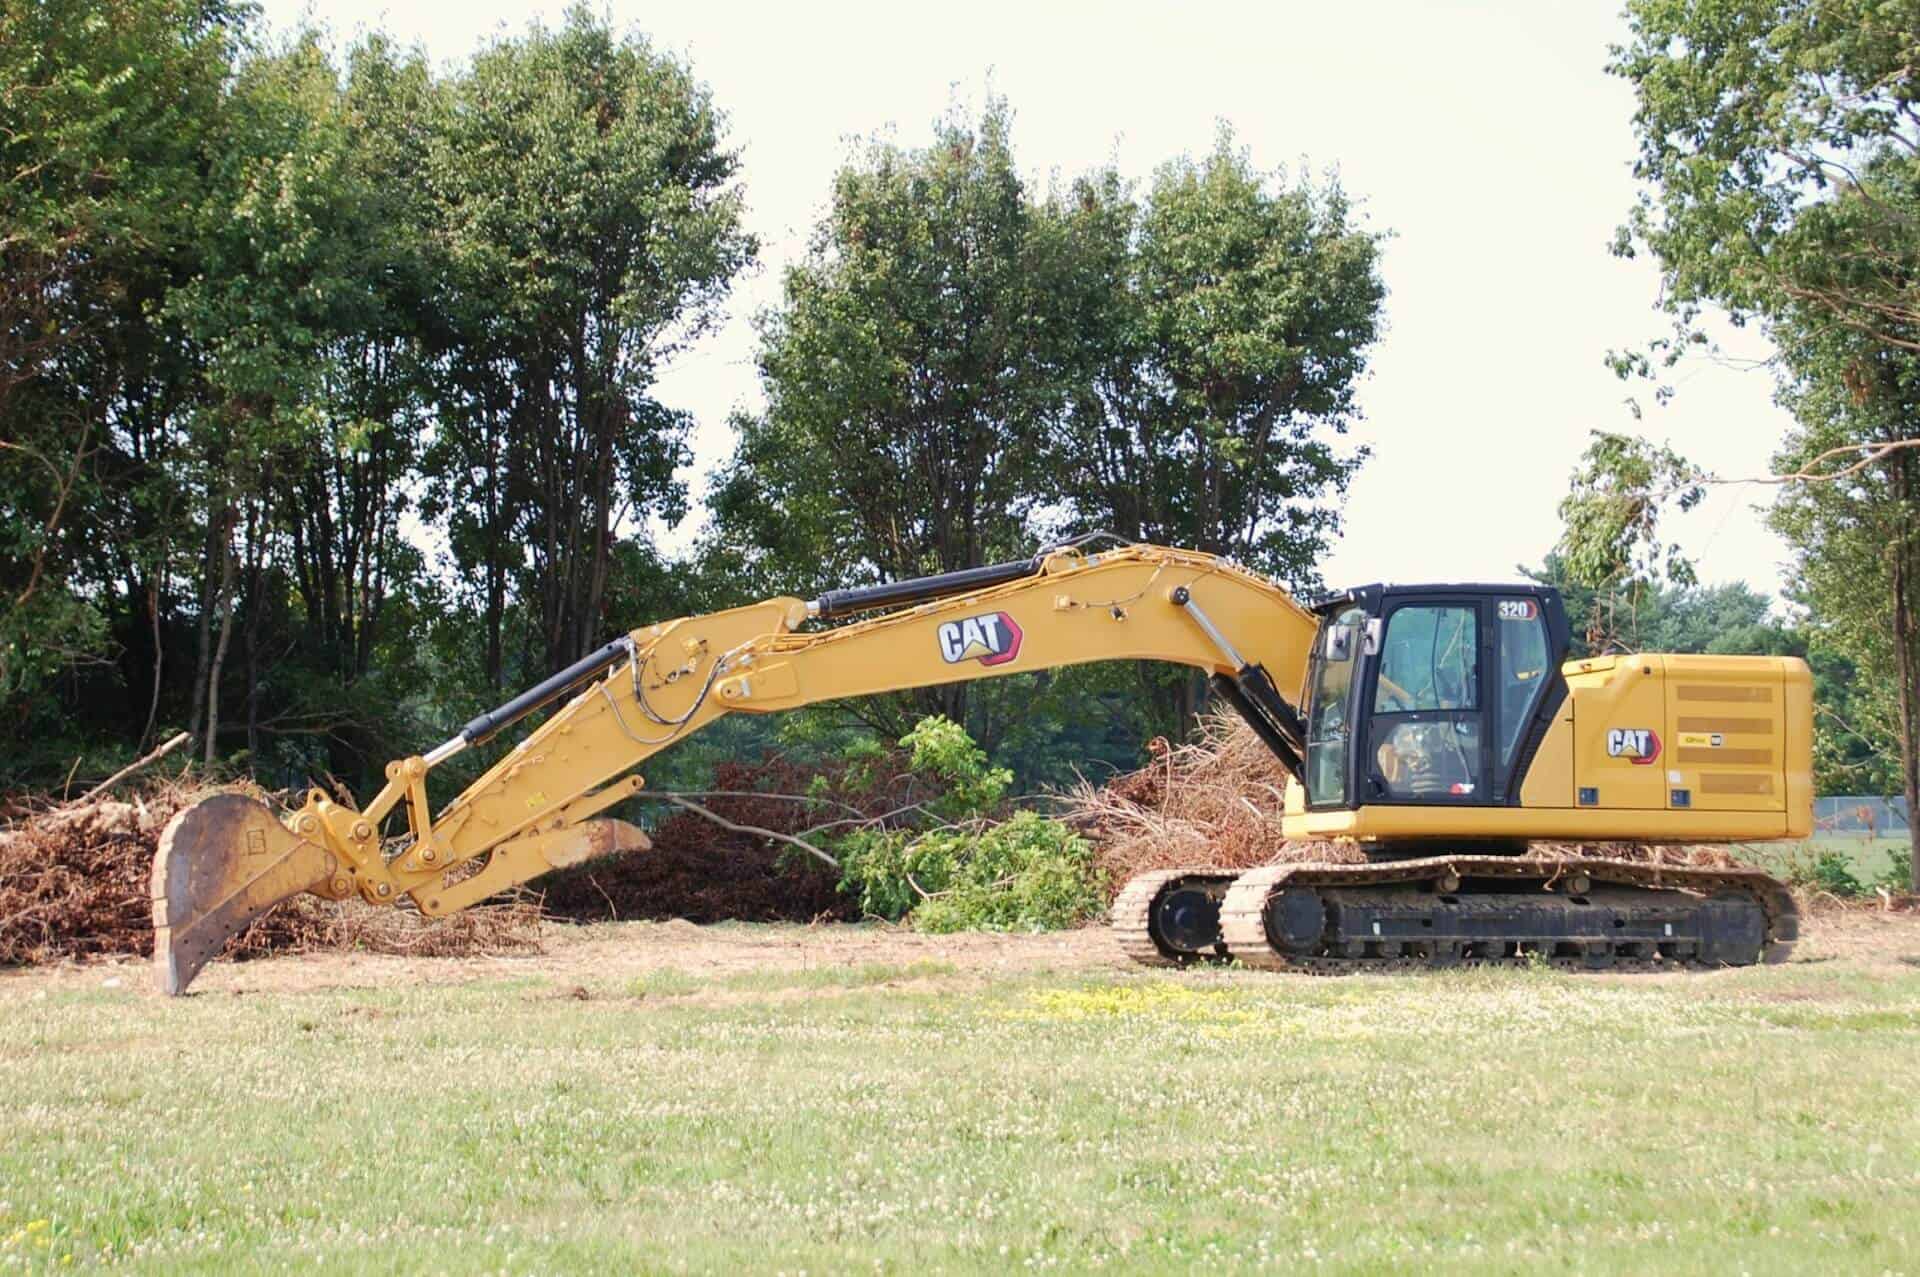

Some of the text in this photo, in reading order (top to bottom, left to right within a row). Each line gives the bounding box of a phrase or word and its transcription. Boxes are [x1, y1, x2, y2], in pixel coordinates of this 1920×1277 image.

[1498, 601, 1527, 618] 320
[938, 613, 1001, 662] CAT
[1608, 729, 1649, 757] CAT
